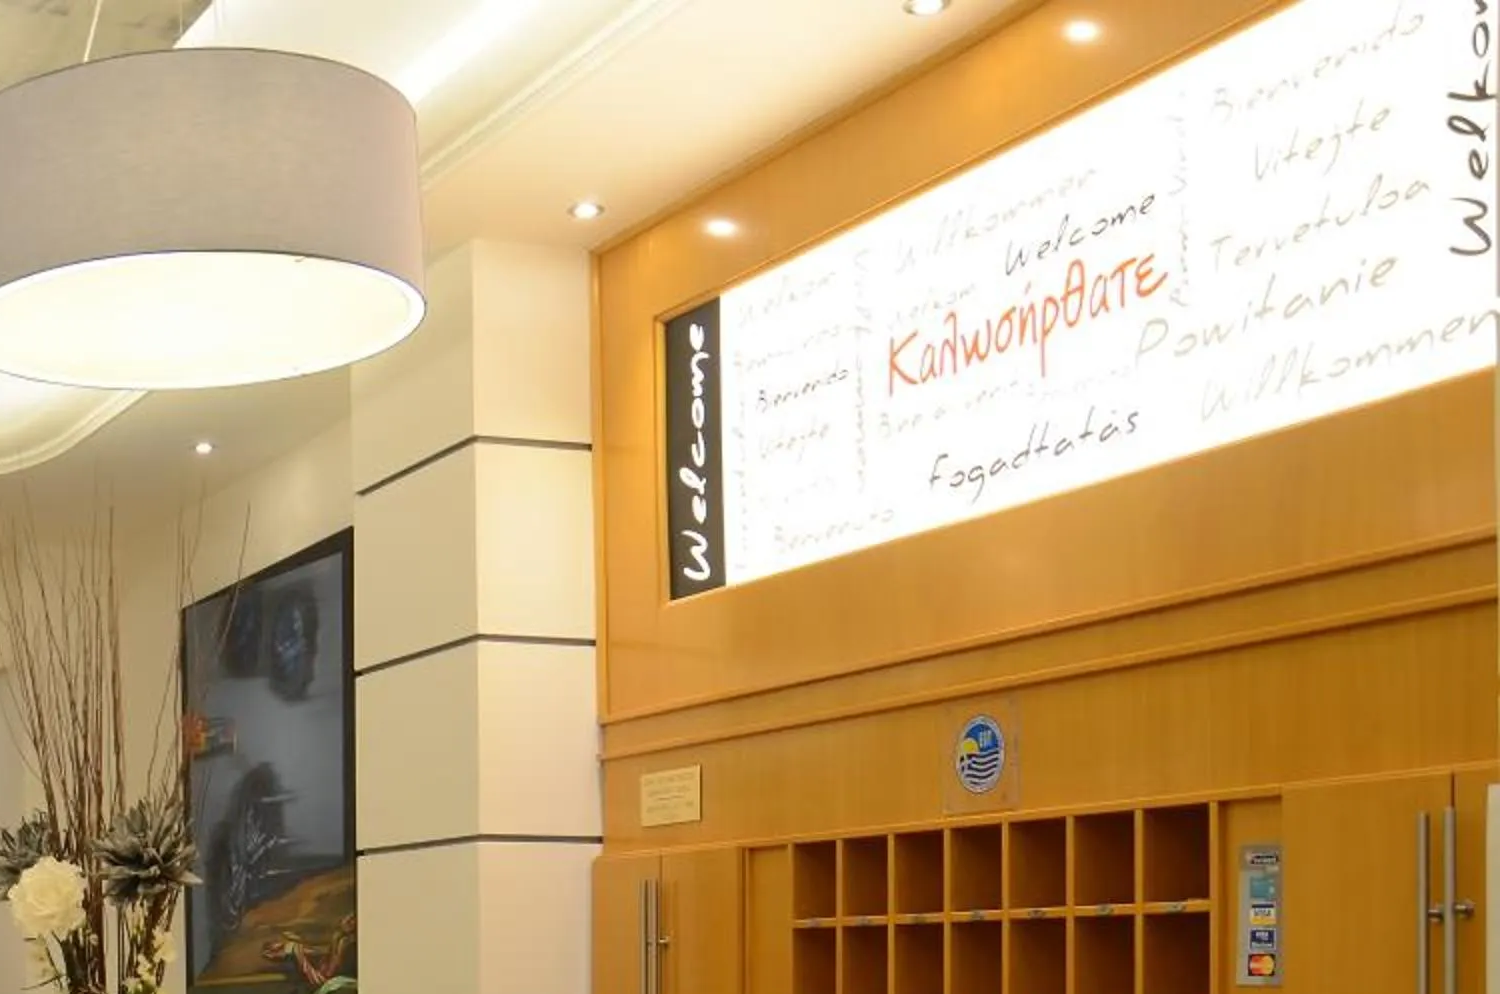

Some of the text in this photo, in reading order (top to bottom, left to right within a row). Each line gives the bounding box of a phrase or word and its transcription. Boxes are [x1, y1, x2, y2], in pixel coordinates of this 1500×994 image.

[1003, 193, 1157, 277] Welcome
[888, 252, 1169, 398] Καλωσήρθατε
[1134, 256, 1400, 369] Powitanie
[678, 322, 712, 581] Welcome
